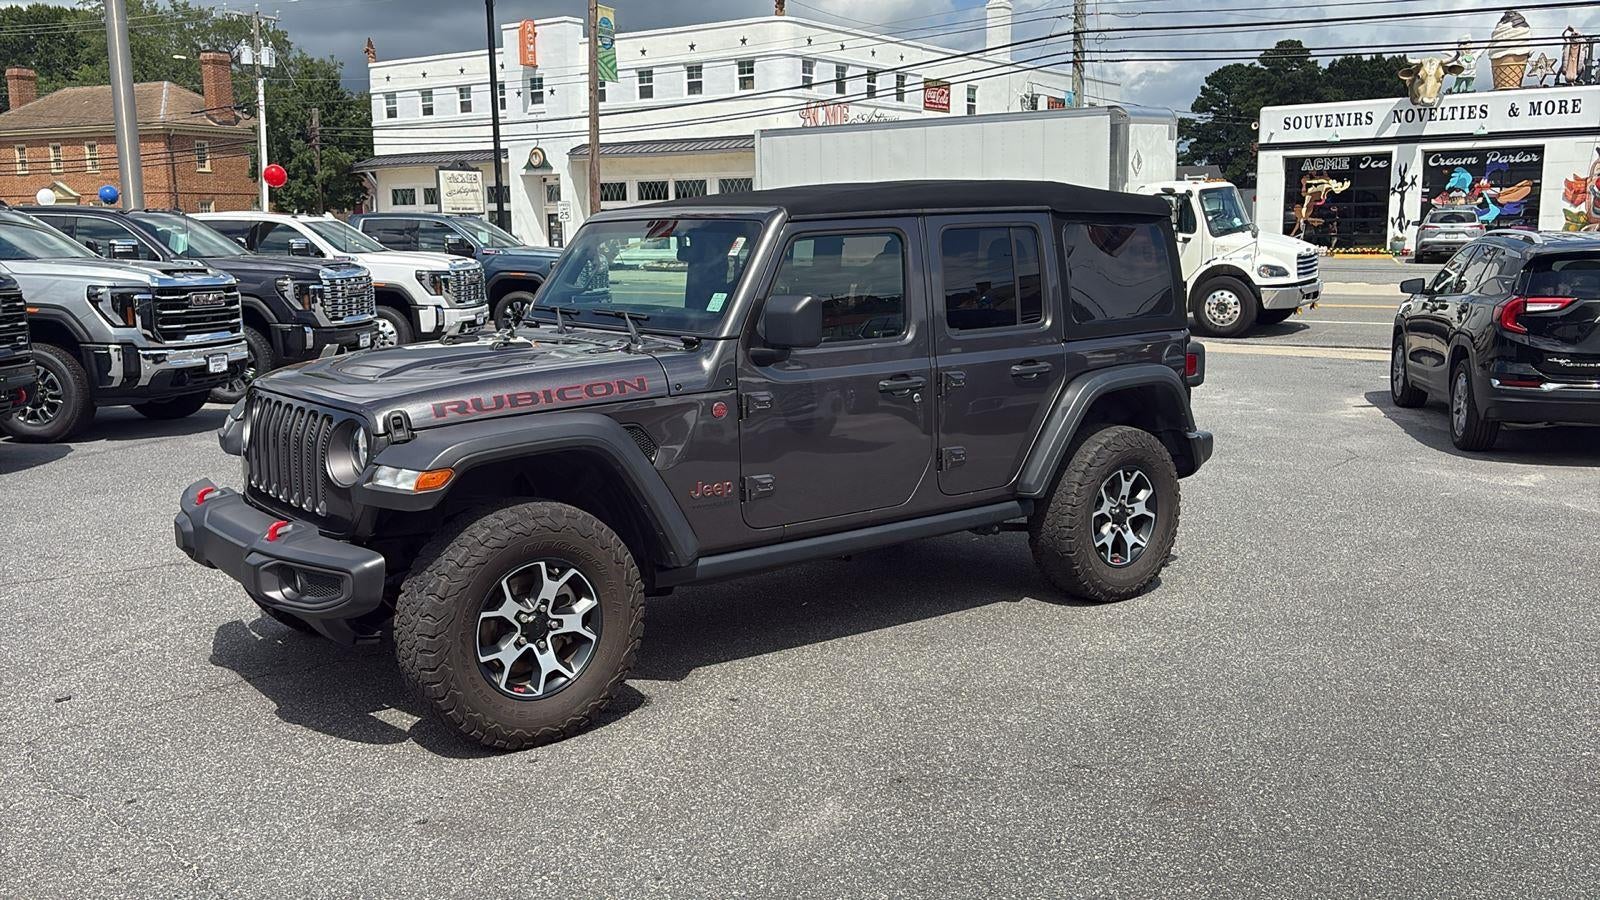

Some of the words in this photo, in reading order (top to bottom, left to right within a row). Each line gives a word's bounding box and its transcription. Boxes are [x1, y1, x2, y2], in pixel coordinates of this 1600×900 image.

[1283, 111, 1374, 130] SOUVENIRS
[1391, 104, 1489, 124] NOVELTIES
[1508, 102, 1520, 118] &
[1528, 98, 1582, 116] MORE
[1301, 157, 1350, 170] ACME
[1359, 156, 1389, 168] Ice
[1428, 153, 1479, 166] Cream
[1486, 151, 1541, 164] Parlor
[560, 211, 570, 219] 25
[193, 294, 225, 305] GMC
[430, 375, 649, 420] RUBICON
[689, 480, 733, 499] Jeep
